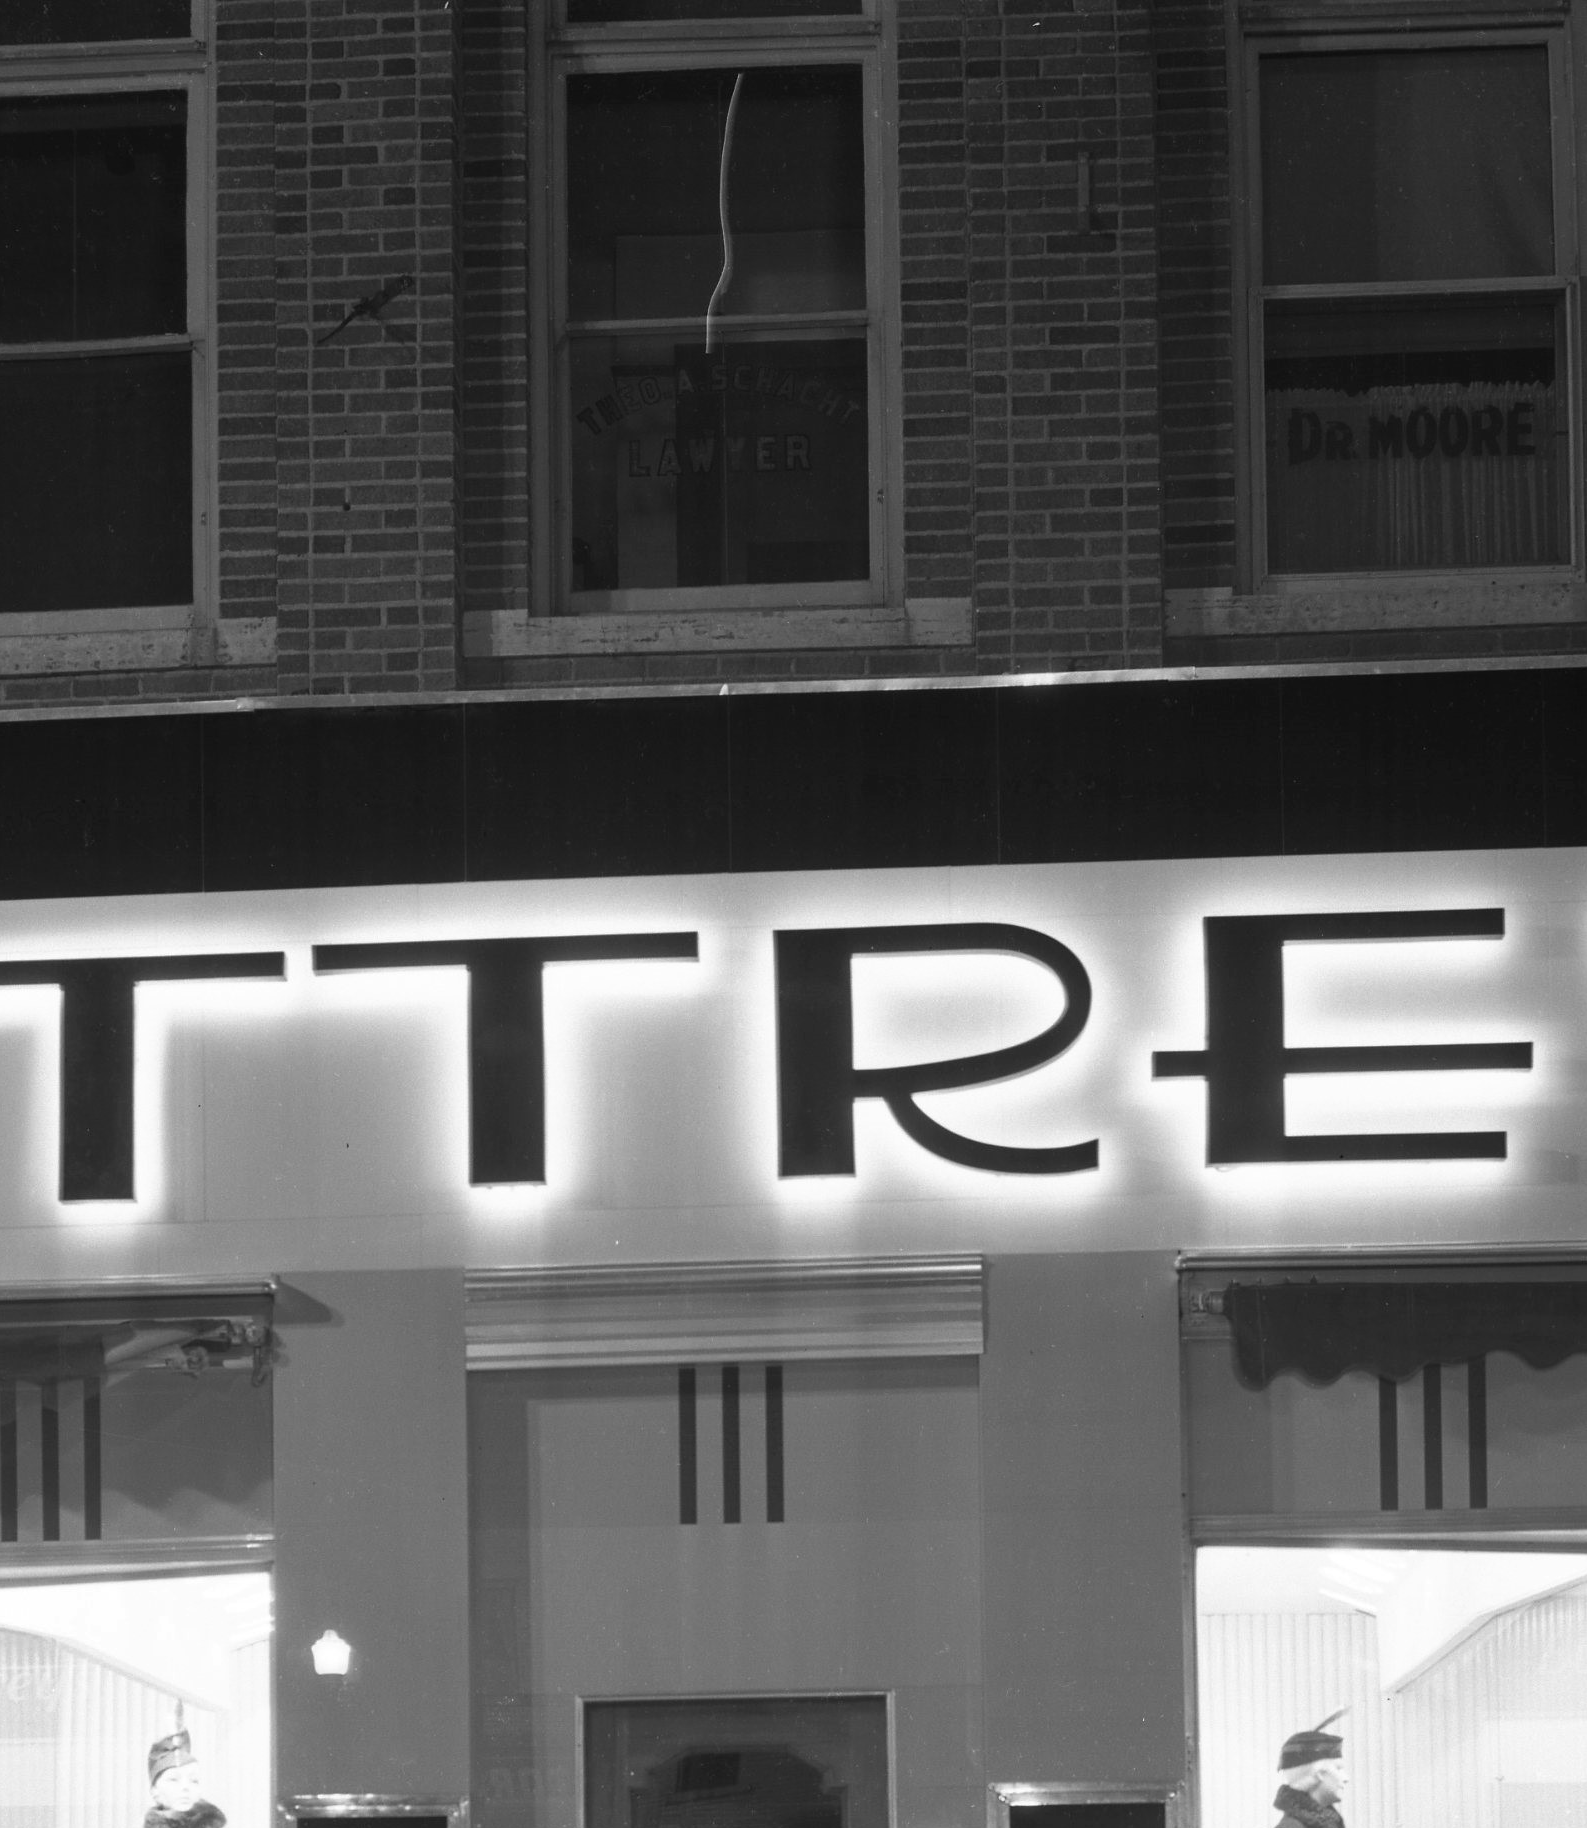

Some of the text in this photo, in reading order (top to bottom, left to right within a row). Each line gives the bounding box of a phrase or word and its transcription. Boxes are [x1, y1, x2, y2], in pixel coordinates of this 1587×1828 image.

[711, 363, 862, 425] SCHACHT
[627, 432, 812, 478] LAWYER
[1367, 401, 1537, 459] MOORE
